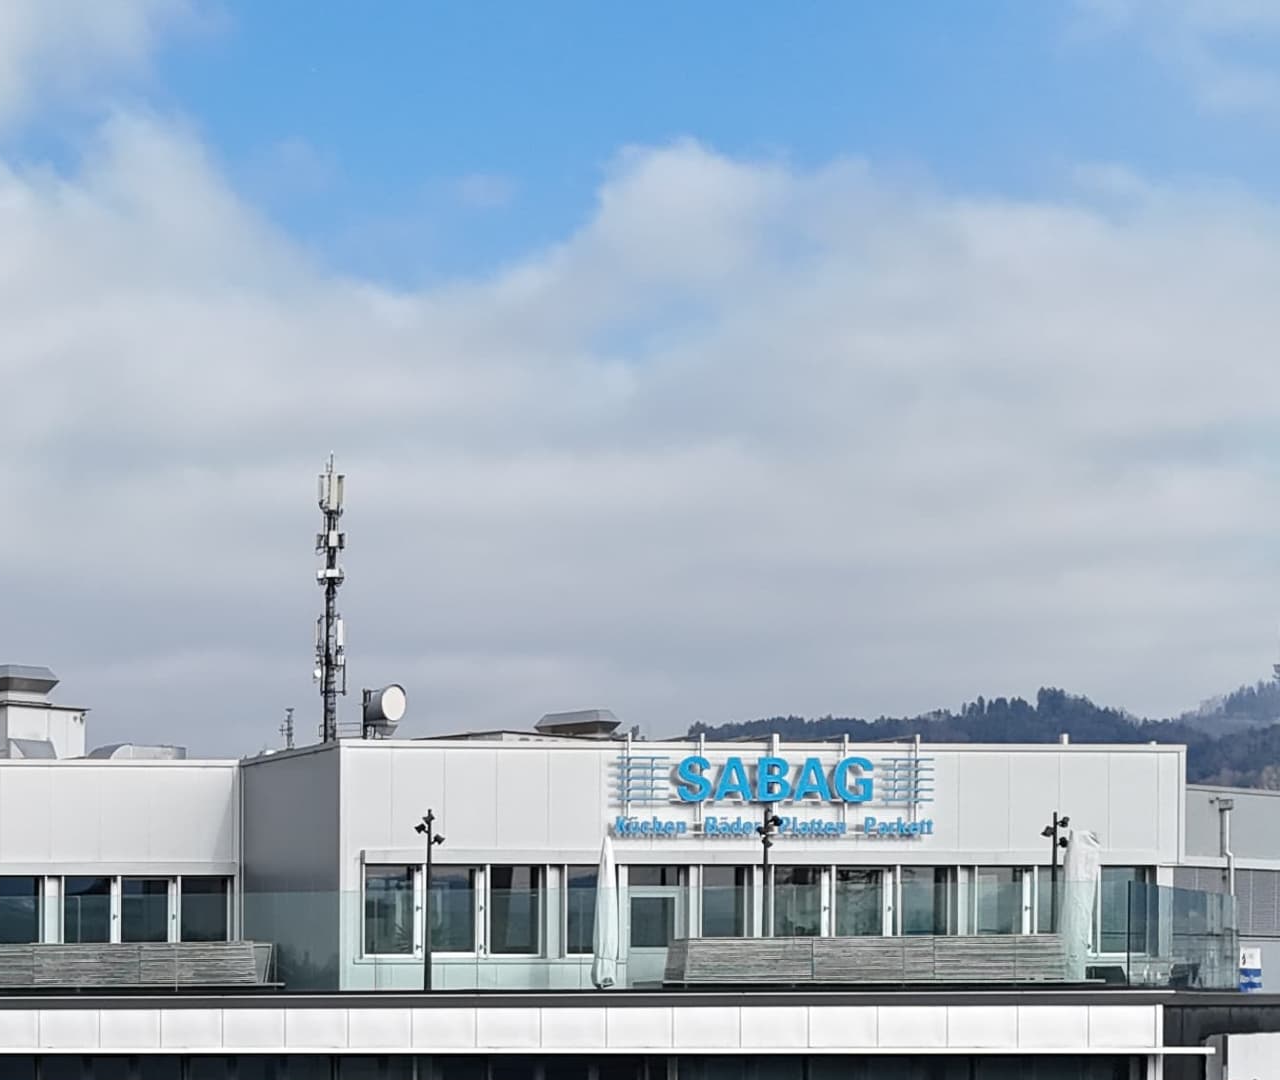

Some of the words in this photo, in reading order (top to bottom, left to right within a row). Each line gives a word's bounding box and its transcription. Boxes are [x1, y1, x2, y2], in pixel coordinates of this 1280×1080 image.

[676, 756, 874, 804] SABAG
[616, 816, 688, 834] Küchen
[864, 816, 933, 834] Parkett
